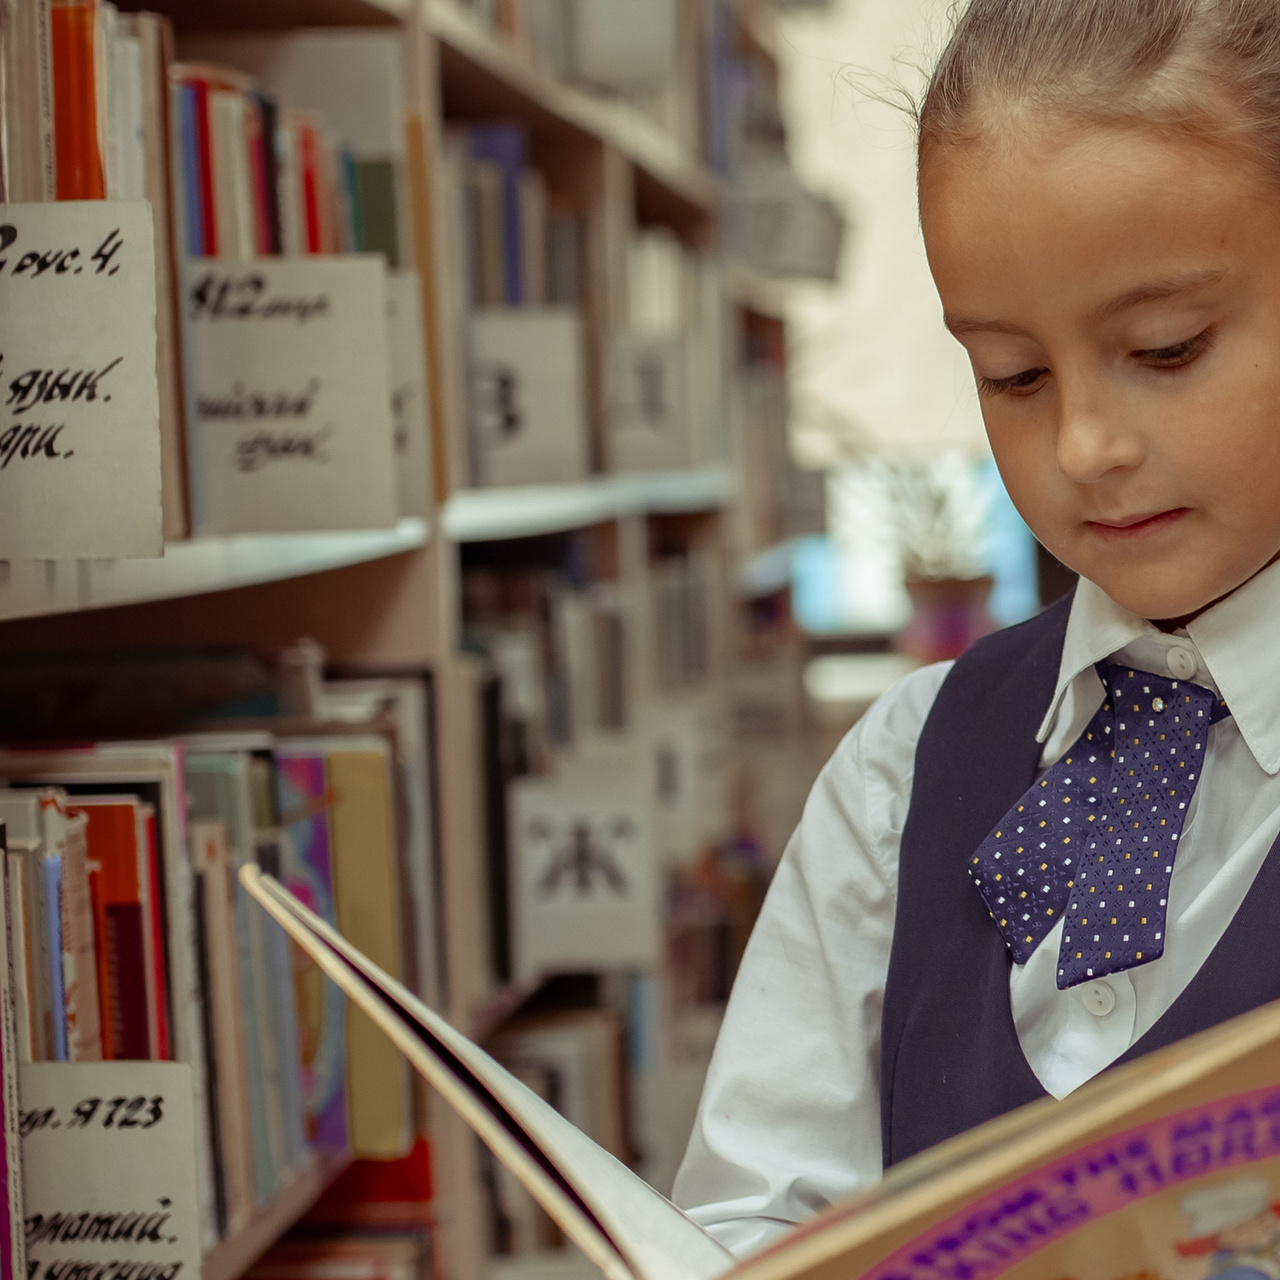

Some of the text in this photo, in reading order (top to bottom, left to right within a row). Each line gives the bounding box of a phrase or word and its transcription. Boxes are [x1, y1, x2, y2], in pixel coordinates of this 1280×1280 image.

[524, 816, 638, 902] Ж
[909, 1187, 1042, 1270] FROM
[1052, 1138, 1149, 1190] THE
